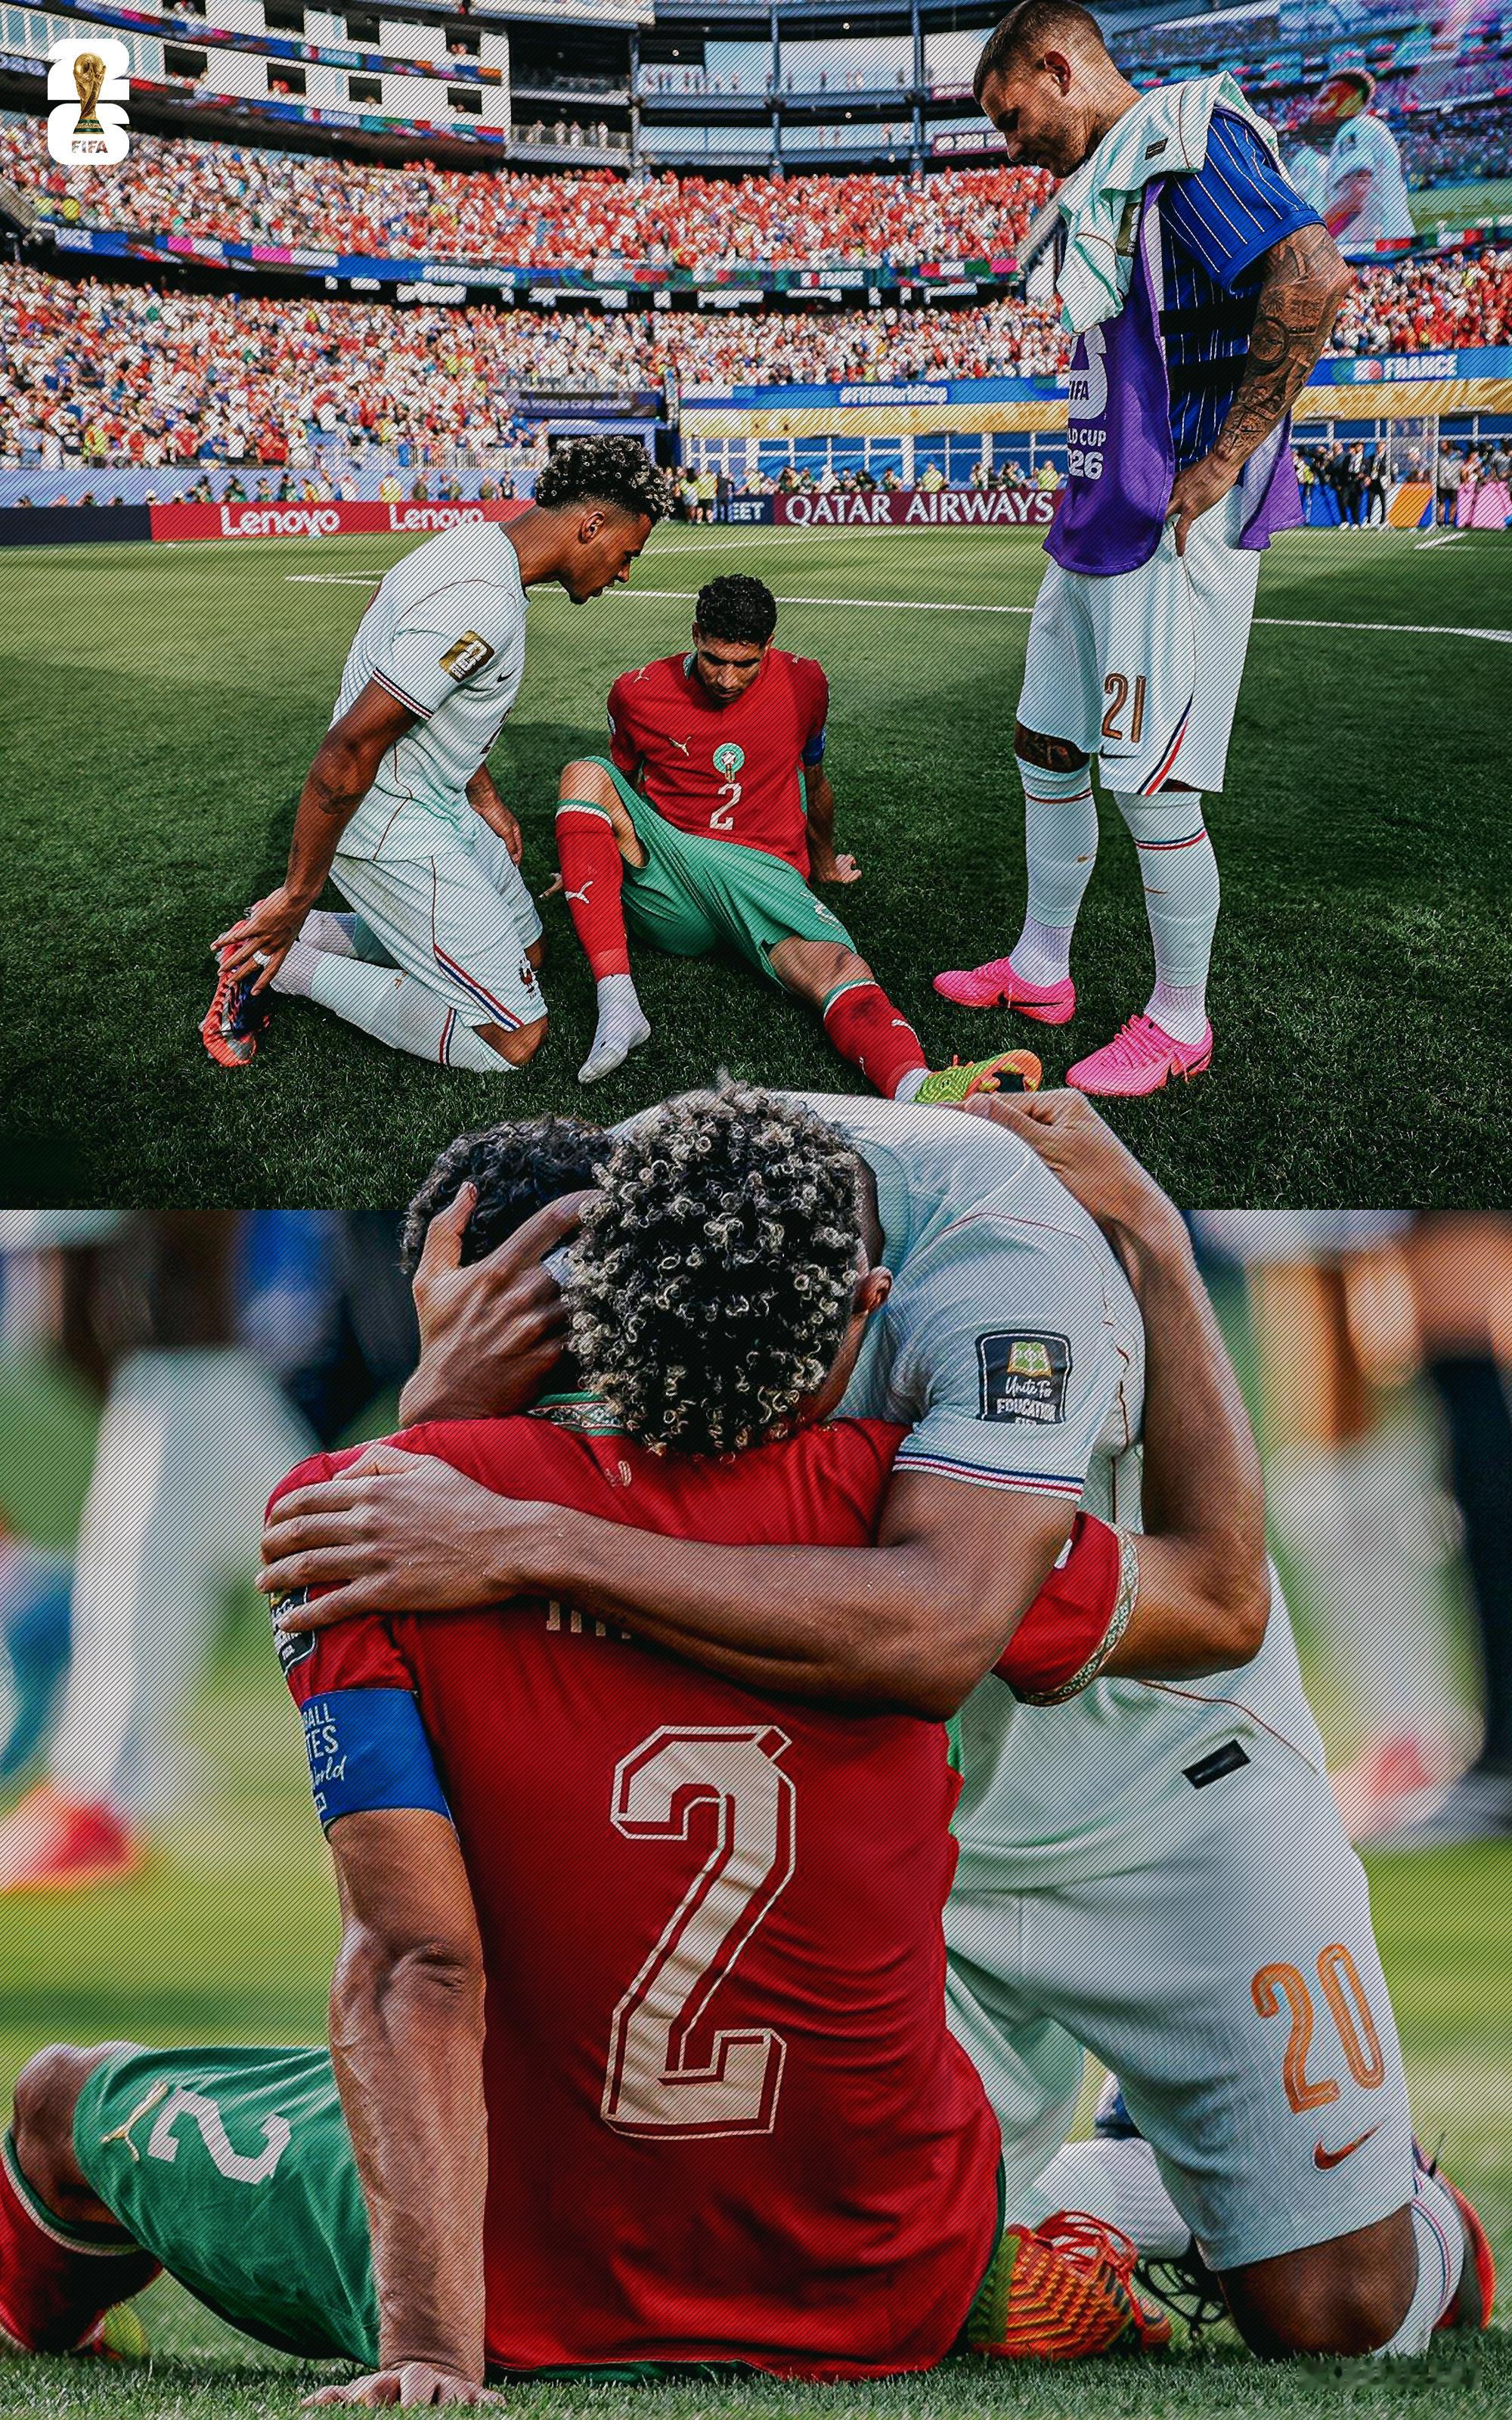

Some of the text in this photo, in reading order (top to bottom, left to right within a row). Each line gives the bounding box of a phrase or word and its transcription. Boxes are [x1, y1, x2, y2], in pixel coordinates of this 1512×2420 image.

[1384, 354, 1458, 380] FRANCE
[1069, 380, 1089, 401] IFA
[1080, 428, 1107, 447] CUP
[220, 505, 340, 538] Lenovo
[389, 504, 484, 529] Lenovo
[785, 492, 1054, 528] QATAR AIRWAYS
[1101, 672, 1147, 743] 21
[709, 783, 742, 830] 2
[1005, 1376, 1038, 1398] Unite
[602, 1725, 797, 2139] 2
[1251, 1942, 1385, 2114] 20
[147, 2086, 292, 2186] 2
